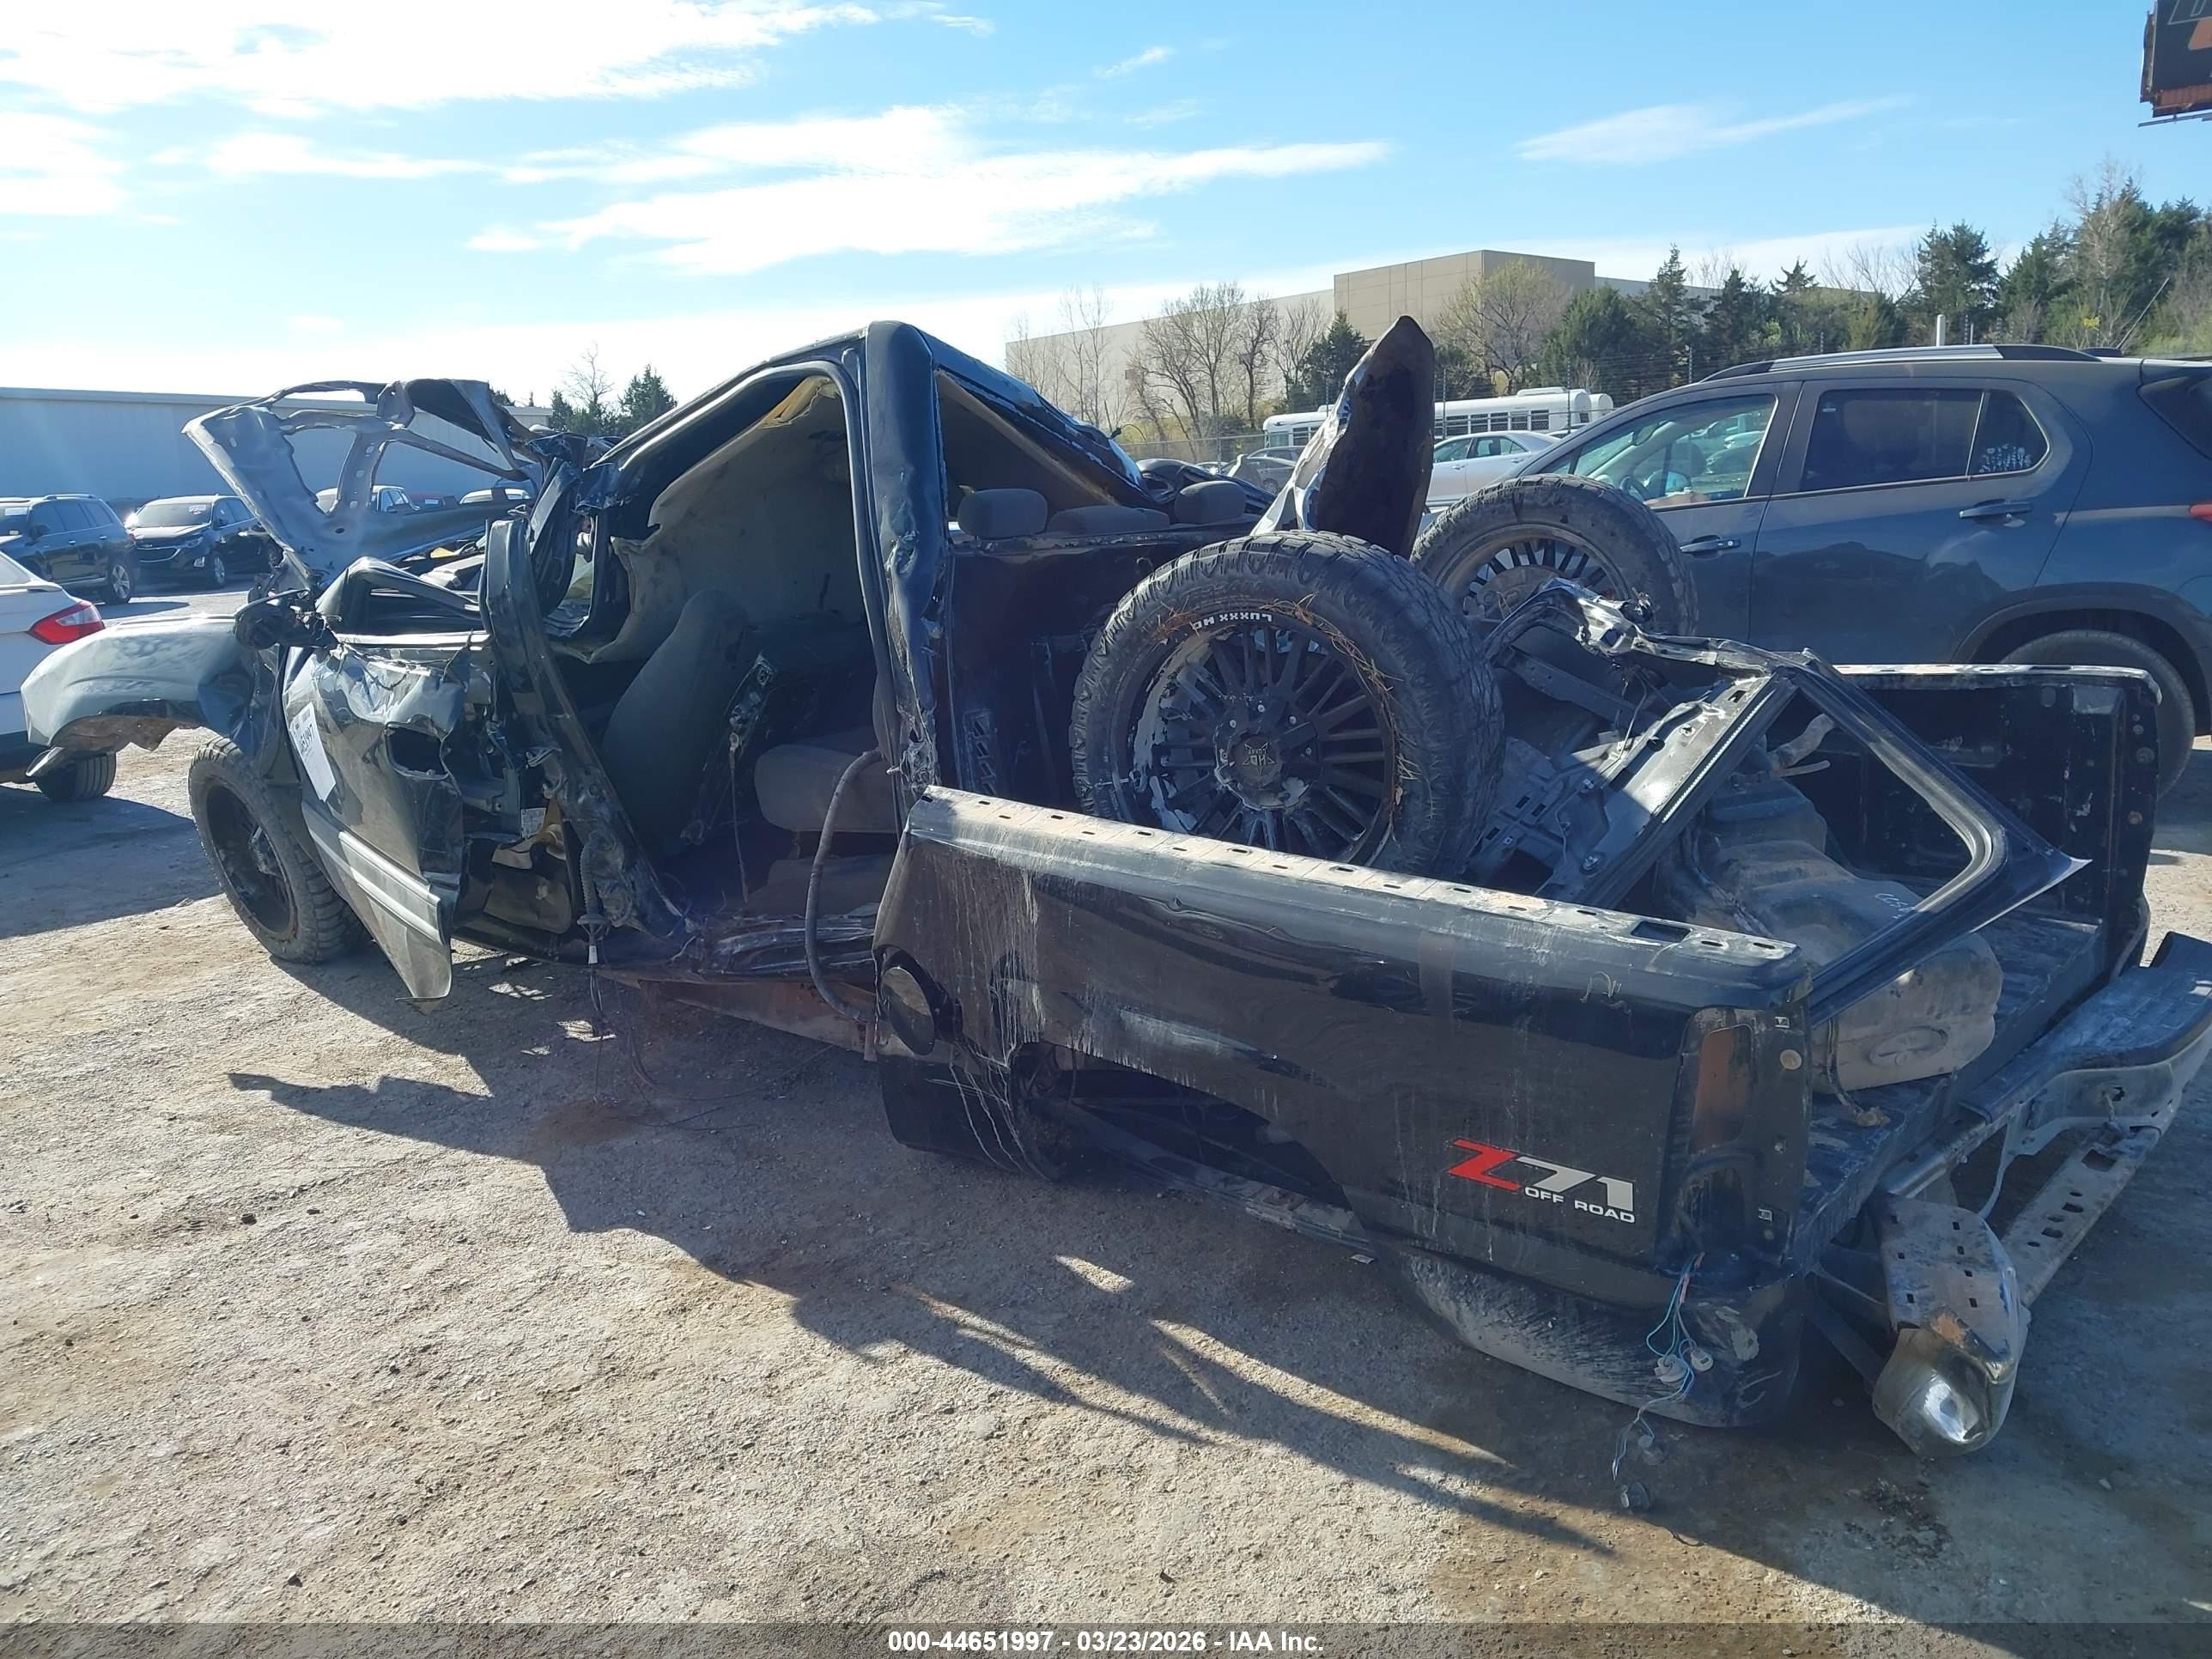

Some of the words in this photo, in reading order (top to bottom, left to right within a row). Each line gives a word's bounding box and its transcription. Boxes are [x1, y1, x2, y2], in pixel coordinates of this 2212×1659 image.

[1448, 1139, 1633, 1212] Z71
[1524, 1187, 1565, 1204] OFF
[1574, 1200, 1636, 1224] ROAD
